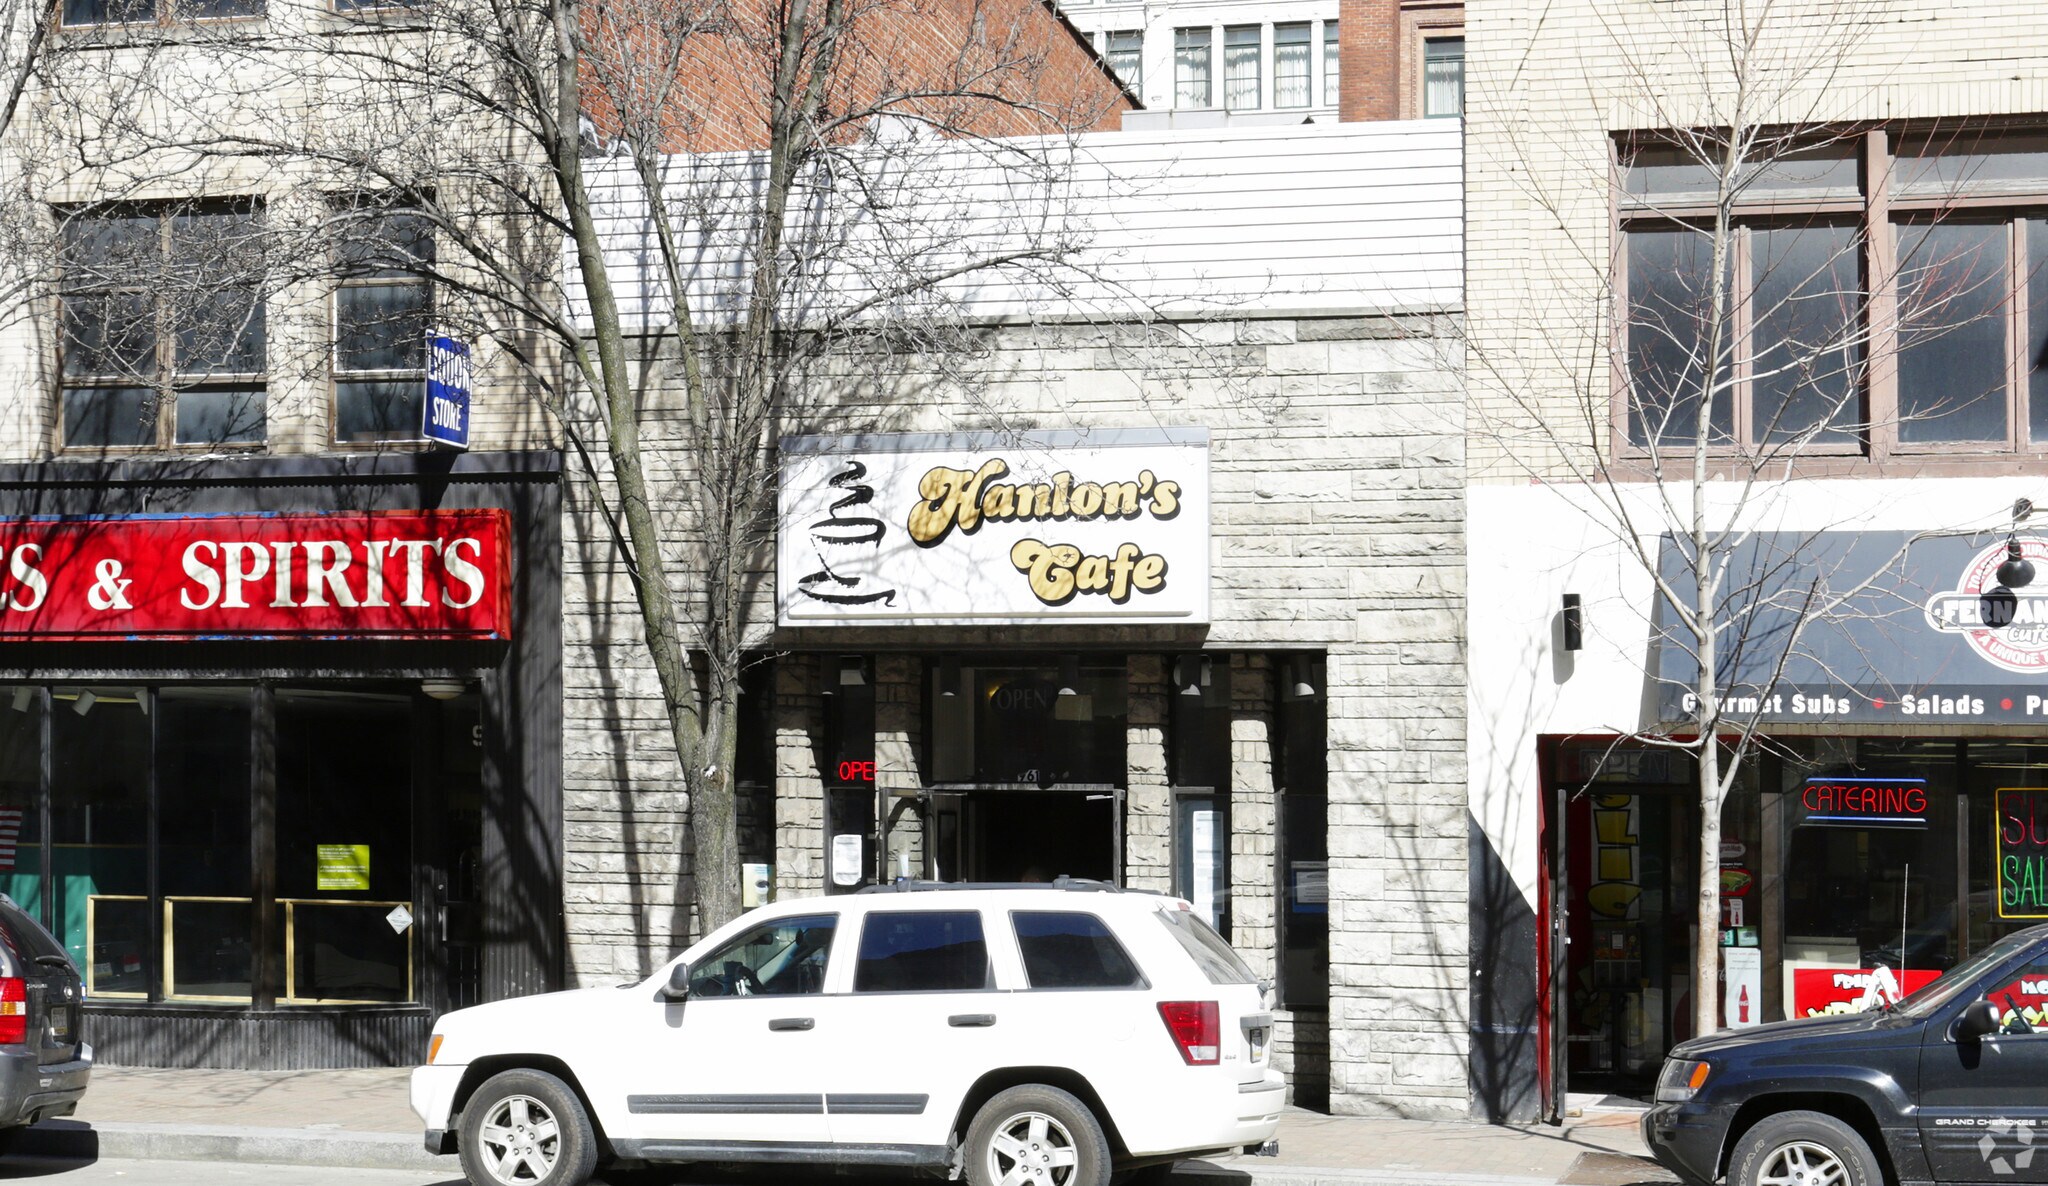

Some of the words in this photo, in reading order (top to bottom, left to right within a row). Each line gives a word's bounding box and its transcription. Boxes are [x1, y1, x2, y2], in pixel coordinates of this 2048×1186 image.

[432, 396, 463, 432] STORE
[907, 457, 1182, 548] Hanlon's
[87, 557, 134, 610] &
[180, 536, 485, 610] SPIRITS
[1010, 538, 1168, 606] Cafe
[1989, 641, 2039, 664] UNIQUE
[996, 687, 1048, 711] OPEN
[1682, 692, 1782, 714] Gurmet
[1792, 693, 1851, 714] Subs
[1902, 693, 1985, 715] Salads
[838, 760, 878, 782] OPE
[1802, 785, 1928, 814] CATERING
[1935, 1118, 1974, 1126] GRAND
[1977, 1118, 2037, 1126] CHEROKEE
